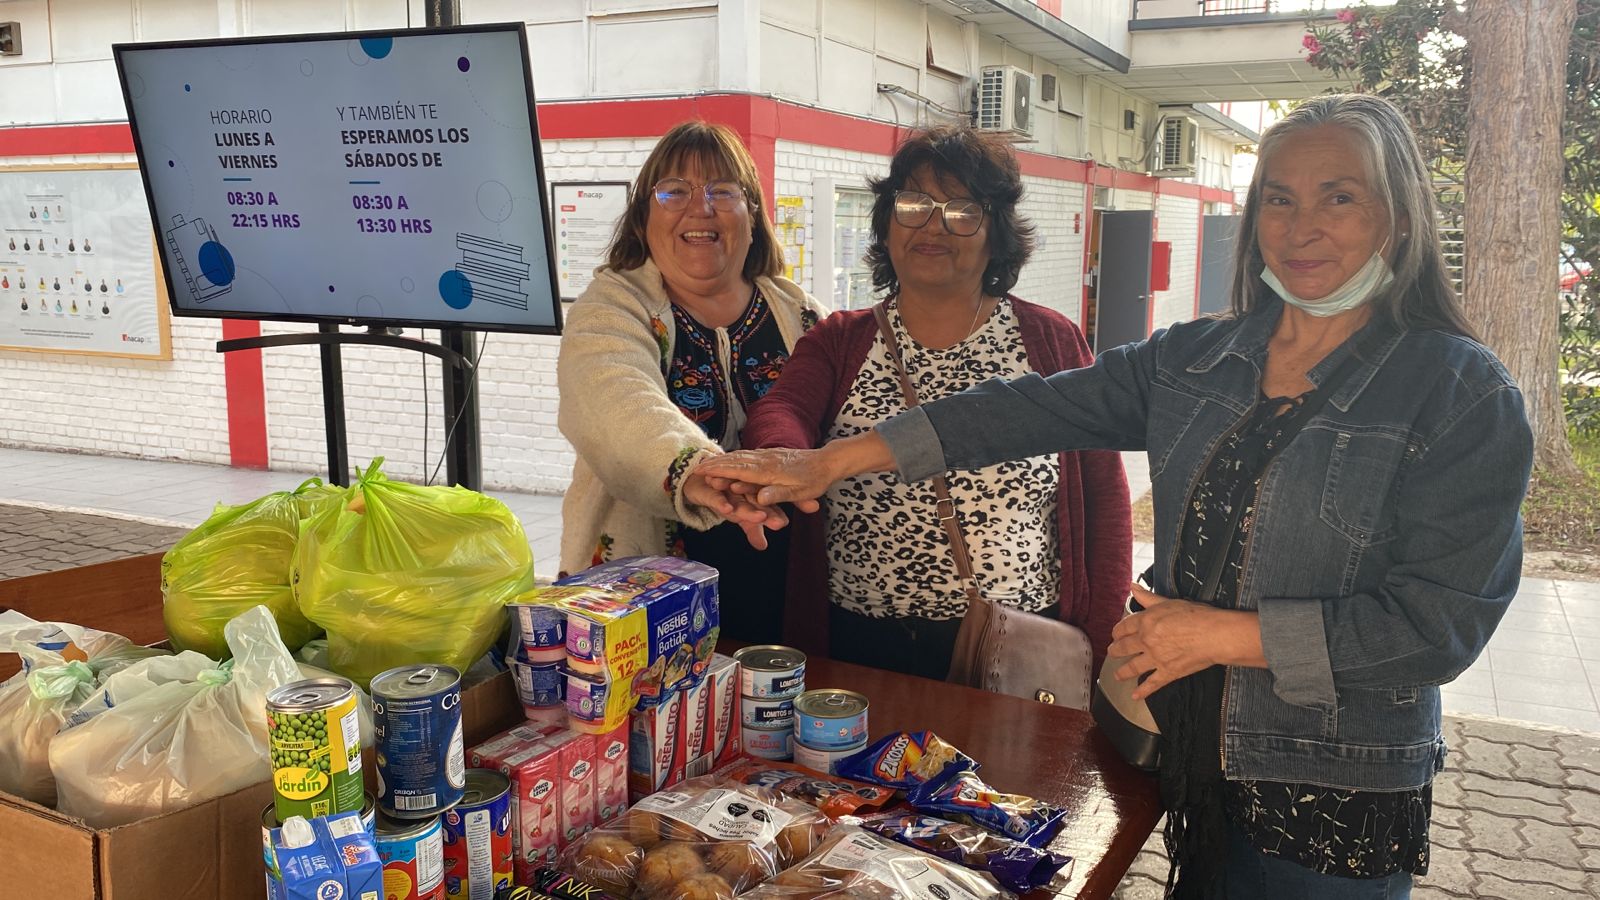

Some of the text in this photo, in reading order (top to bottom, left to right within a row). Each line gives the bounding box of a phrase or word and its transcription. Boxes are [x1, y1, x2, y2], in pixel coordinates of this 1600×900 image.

[210, 109, 272, 124] HORARIO
[336, 101, 438, 121] Y TAMBIÉN TE
[215, 132, 275, 146] LUNES A
[341, 128, 469, 144] ESPERAMOS LOS
[218, 155, 278, 168] VIERNES
[345, 149, 443, 167] SÁBADOS DE
[227, 192, 278, 205] 08:30 A
[353, 195, 409, 209] 08:30 A
[231, 214, 300, 228] 22:15 HRS
[357, 218, 432, 233] 13:30 HRS
[657, 612, 688, 638] Nestlé
[615, 632, 642, 653] PACK
[617, 660, 634, 678] 12
[719, 674, 735, 742] TRENCITO
[763, 709, 787, 718] LOMITOS
[691, 687, 709, 757] TRENCITO
[660, 702, 679, 773] TRENCITO
[572, 767, 587, 777] LECHE
[533, 782, 549, 793] LONCO
[533, 786, 549, 797] LECHE
[556, 878, 603, 900] NIK
